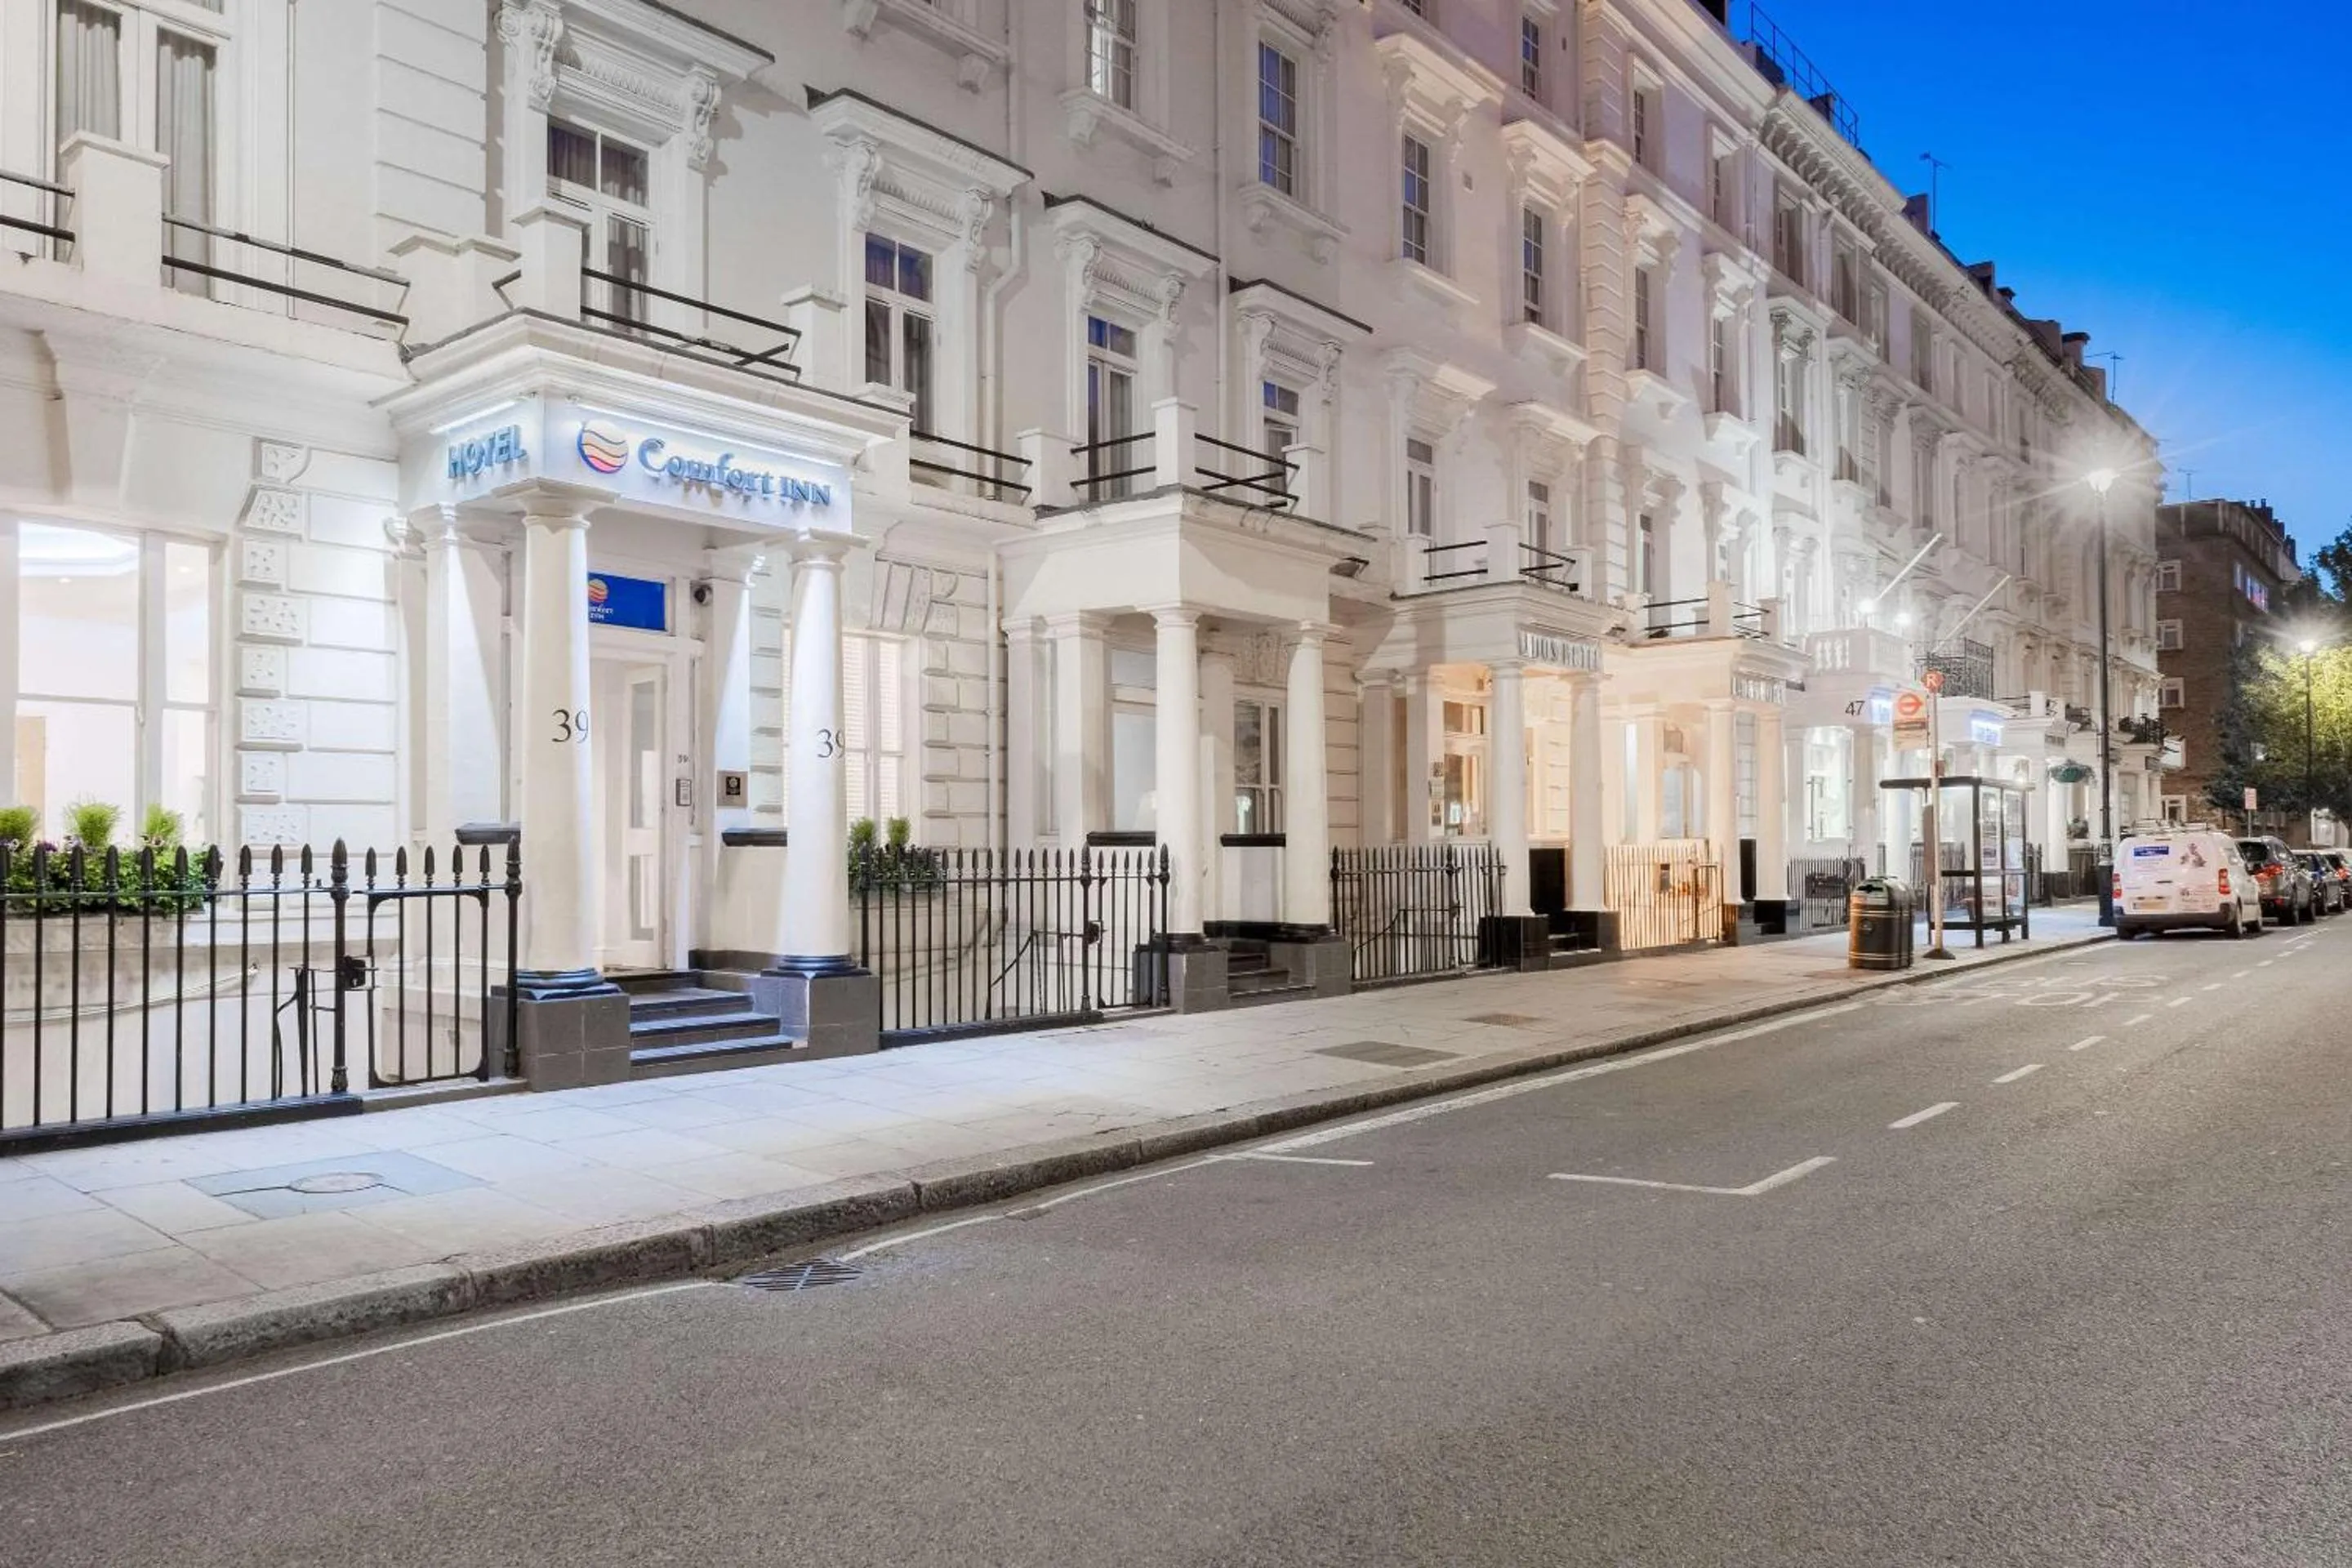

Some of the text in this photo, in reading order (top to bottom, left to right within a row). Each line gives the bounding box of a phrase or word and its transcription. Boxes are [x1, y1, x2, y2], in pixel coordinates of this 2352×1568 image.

[448, 424, 528, 479] HOTEL
[638, 438, 831, 506] Comfort INN
[1845, 701, 1865, 715] 47
[552, 709, 589, 743] 39
[817, 728, 844, 759] 39
